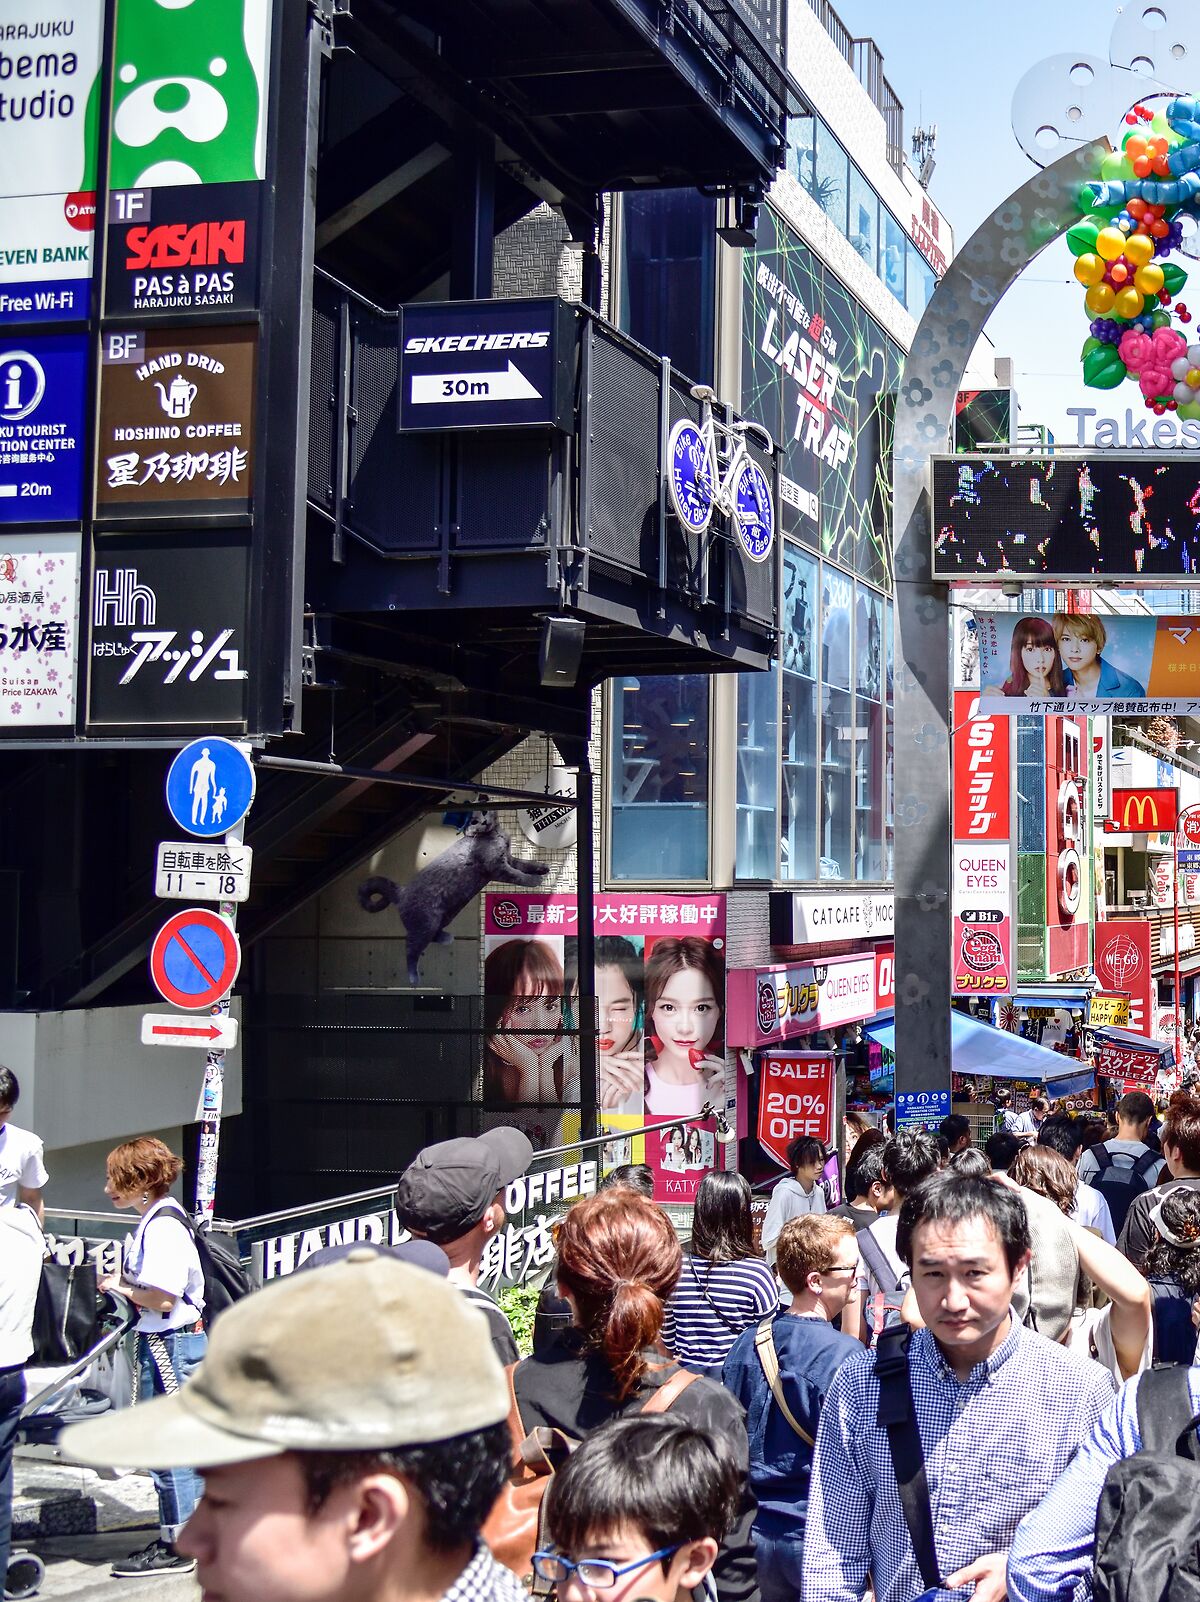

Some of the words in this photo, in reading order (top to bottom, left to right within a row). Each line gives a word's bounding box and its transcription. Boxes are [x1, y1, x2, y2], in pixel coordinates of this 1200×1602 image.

[115, 193, 145, 220] 1F
[42, 245, 89, 263] BANK
[126, 220, 246, 270] SASAKI
[134, 276, 173, 297] PAS
[178, 275, 190, 294] à
[194, 272, 234, 293] PAS
[0, 294, 32, 312] Free
[34, 291, 74, 309] Wi-Fi
[134, 296, 192, 309] HARAJUKU
[194, 293, 234, 306] SASAKI
[108, 335, 138, 360] BF
[404, 332, 550, 354] SKECHERS
[136, 353, 183, 381] HAND
[187, 352, 225, 374] DRIP
[761, 307, 839, 410] LASER
[442, 380, 489, 396] 30m
[17, 424, 67, 437] TOURIST
[114, 426, 181, 441] HOSHINO
[185, 424, 242, 438] COFFEE
[794, 393, 851, 470] TRAP
[31, 438, 76, 451] CENTER
[106, 445, 249, 488] 星乃珈琲
[21, 481, 52, 497] 20m
[94, 569, 157, 626] Hh
[93, 642, 139, 657] はらじゅく
[119, 628, 249, 685] アッシュ
[2, 688, 22, 696] Price
[23, 687, 58, 696] IZAKAYA
[162, 850, 244, 871] 自転車を除く
[958, 858, 1006, 872] QUEEN
[166, 873, 183, 893] 11
[218, 874, 236, 894] 18
[966, 875, 998, 888] EYES
[812, 907, 833, 926] CAT
[835, 906, 860, 924] CAFE
[978, 911, 998, 921] B1F
[826, 977, 852, 999] QUEEN
[853, 974, 869, 993] EYES
[1091, 1001, 1129, 1011] ハッピーワン
[1090, 1013, 1112, 1023] HAPPY
[1113, 1014, 1128, 1024] ONE
[769, 1062, 826, 1079] SALE!
[1099, 1067, 1156, 1082] SQUEEZE
[1101, 1056, 1157, 1076] スクイーズ
[767, 1092, 825, 1115] 20%
[769, 1118, 821, 1140] OFF
[505, 1162, 597, 1215] OFFEE
